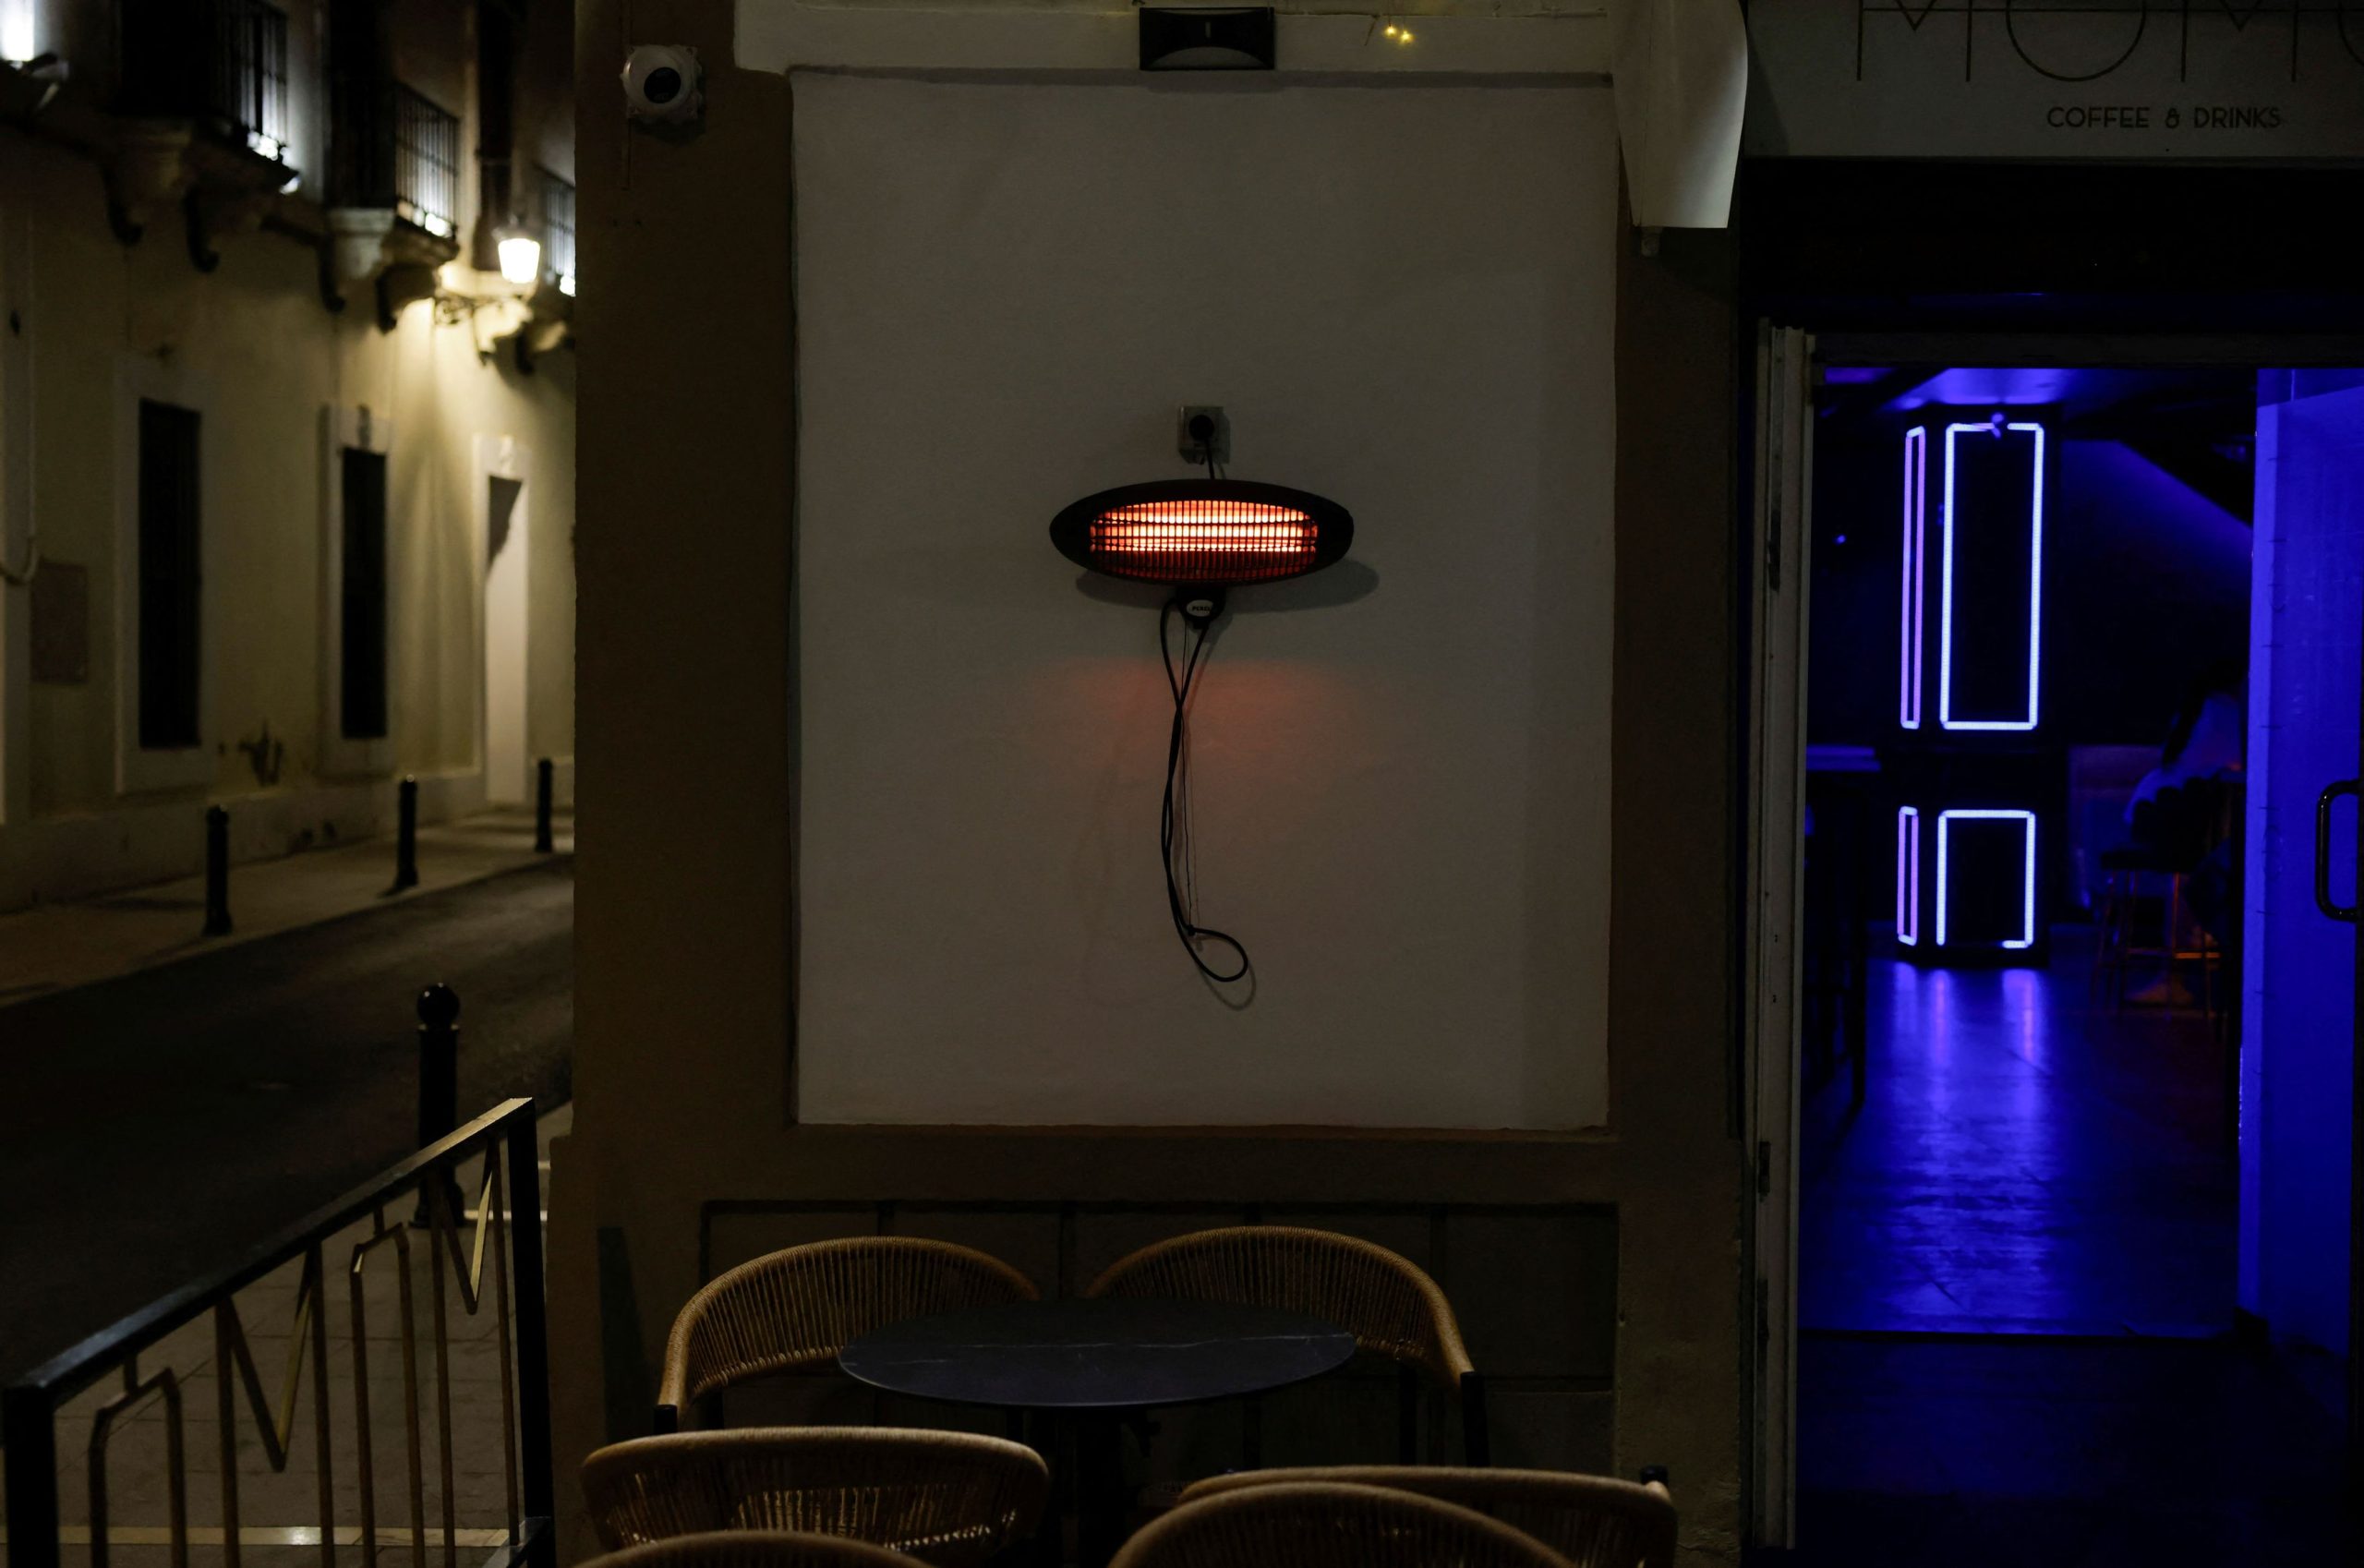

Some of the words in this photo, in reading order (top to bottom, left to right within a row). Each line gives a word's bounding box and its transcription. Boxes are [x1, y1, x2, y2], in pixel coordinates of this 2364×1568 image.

[1857, 0, 2364, 82] MOM
[2047, 106, 2150, 127] COFFEE
[2165, 107, 2180, 129] &
[2194, 106, 2281, 128] DRINKS
